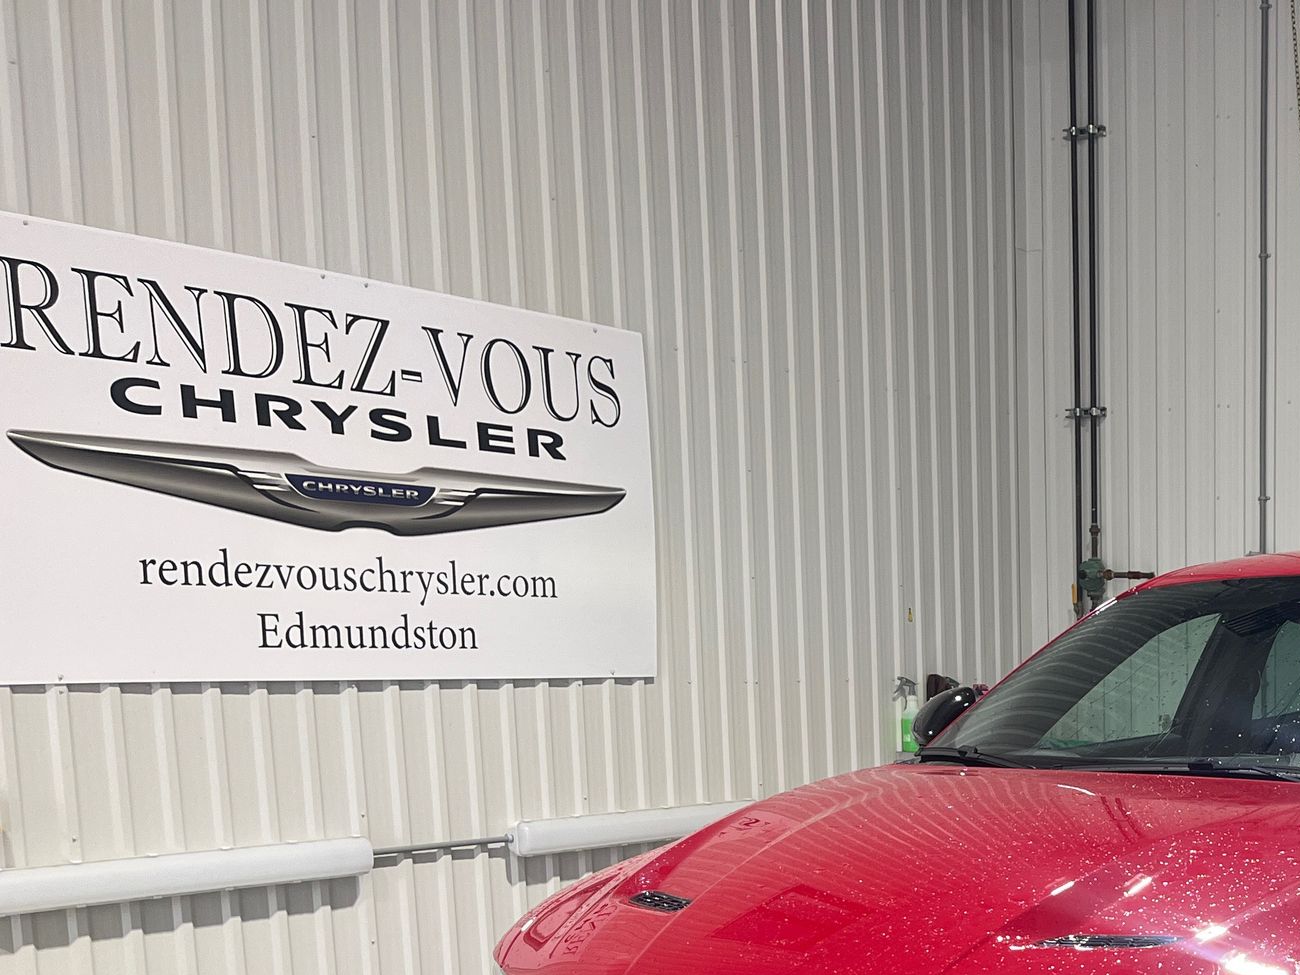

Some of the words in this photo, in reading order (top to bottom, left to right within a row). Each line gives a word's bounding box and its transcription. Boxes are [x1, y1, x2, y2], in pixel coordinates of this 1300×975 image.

[0, 255, 621, 428] RENDEZ-VOUS
[109, 377, 567, 461] CHRYSLER
[302, 480, 419, 500] CHRYSLER
[138, 547, 558, 606] rendezvouschrysler.com
[256, 611, 478, 650] Edmundston
